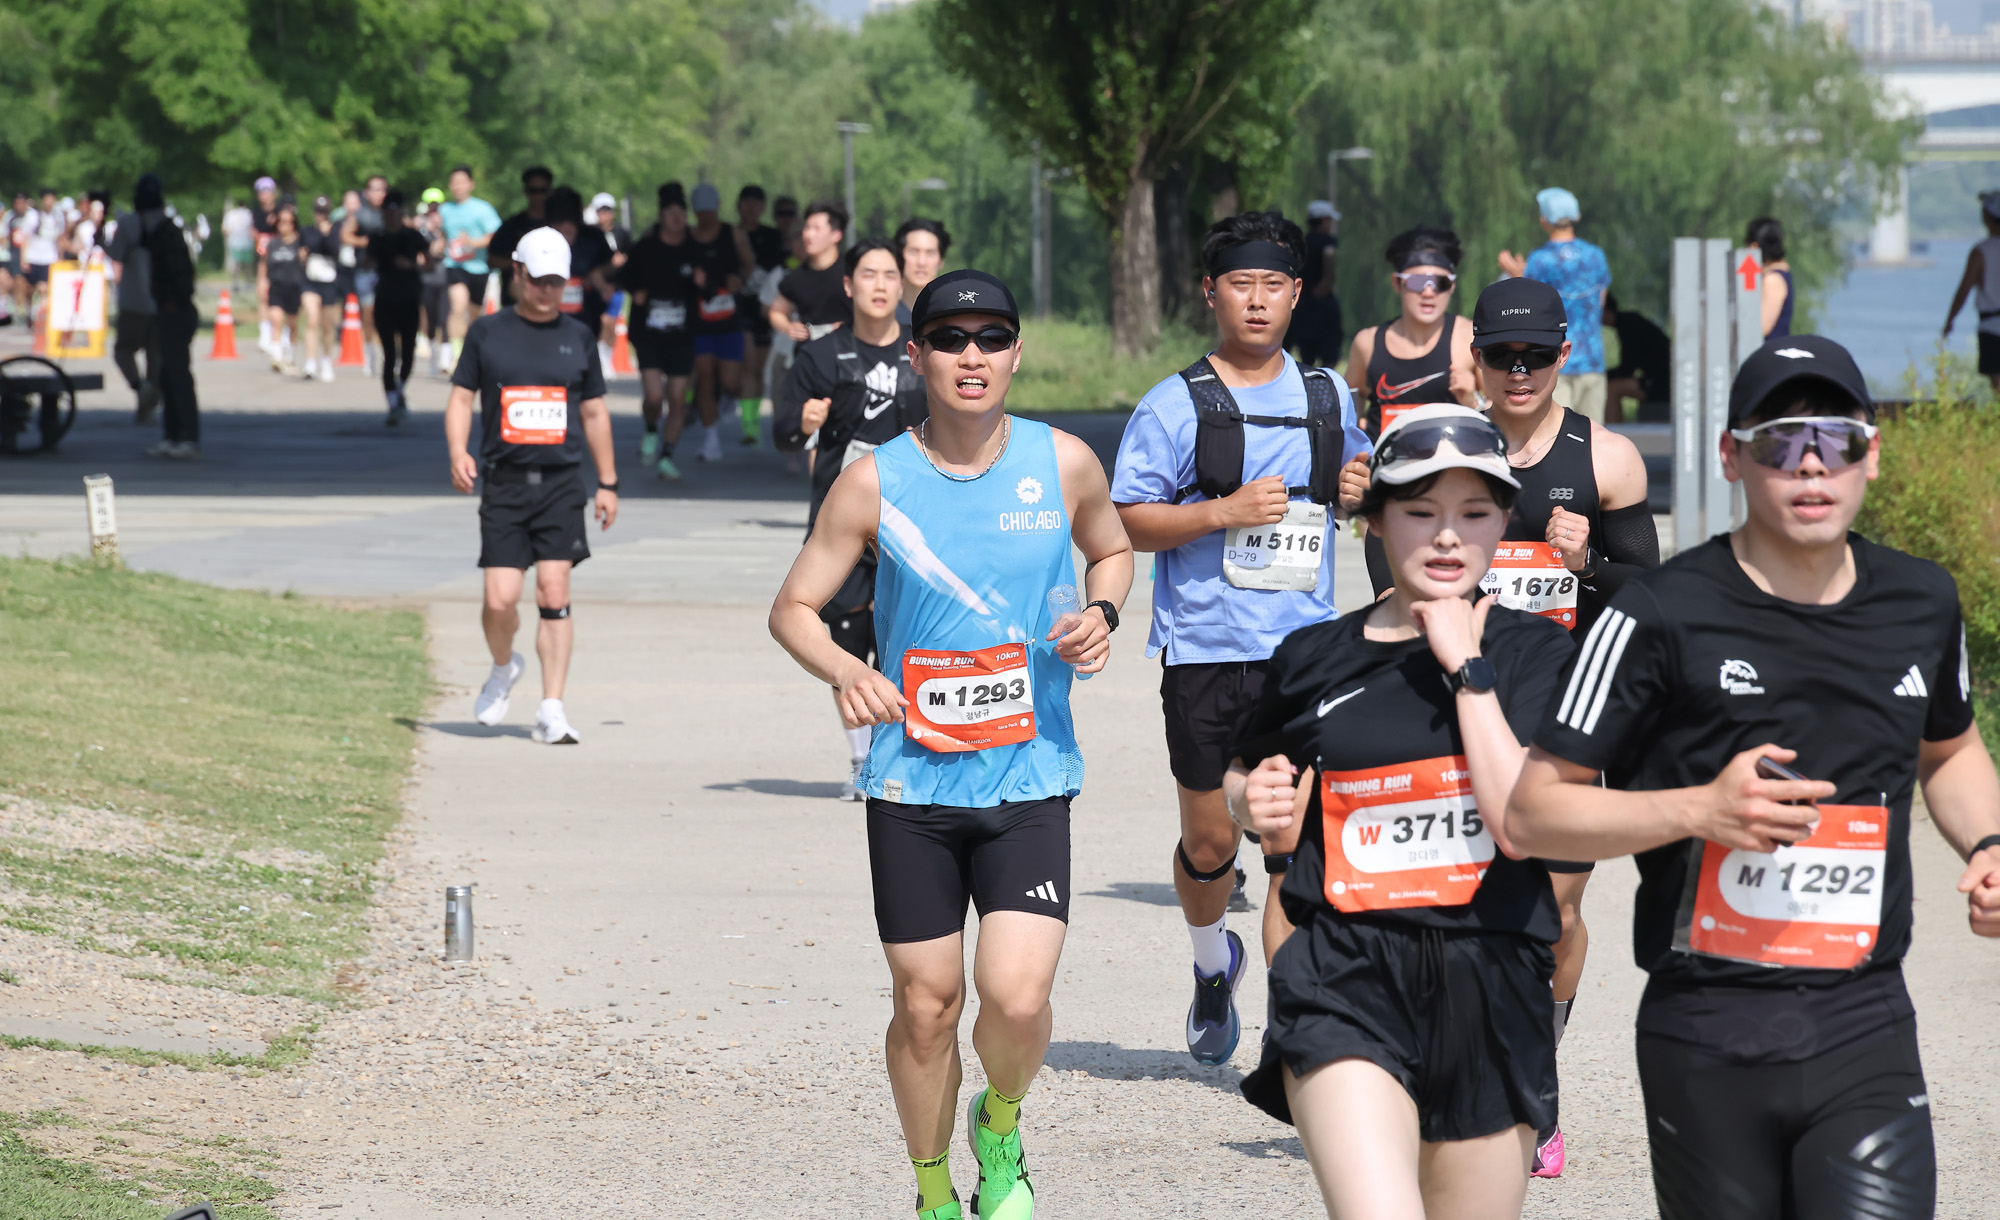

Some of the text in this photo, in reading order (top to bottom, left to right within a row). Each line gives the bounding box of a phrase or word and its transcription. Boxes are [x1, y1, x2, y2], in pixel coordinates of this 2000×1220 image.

[1501, 308, 1531, 317] KIPRUN
[999, 510, 1061, 532] CHICAGO
[1245, 532, 1321, 553] M 5116
[1228, 550, 1257, 562] D-79
[1512, 576, 1575, 597] 1678
[908, 656, 976, 667] BURNING RUN
[995, 651, 1020, 662] 10km
[929, 677, 1026, 707] M 1293
[1329, 773, 1412, 795] BURNING RUN
[1358, 809, 1484, 846] W 3715
[1848, 820, 1880, 834] 10km
[1737, 862, 1876, 895] M 1292
